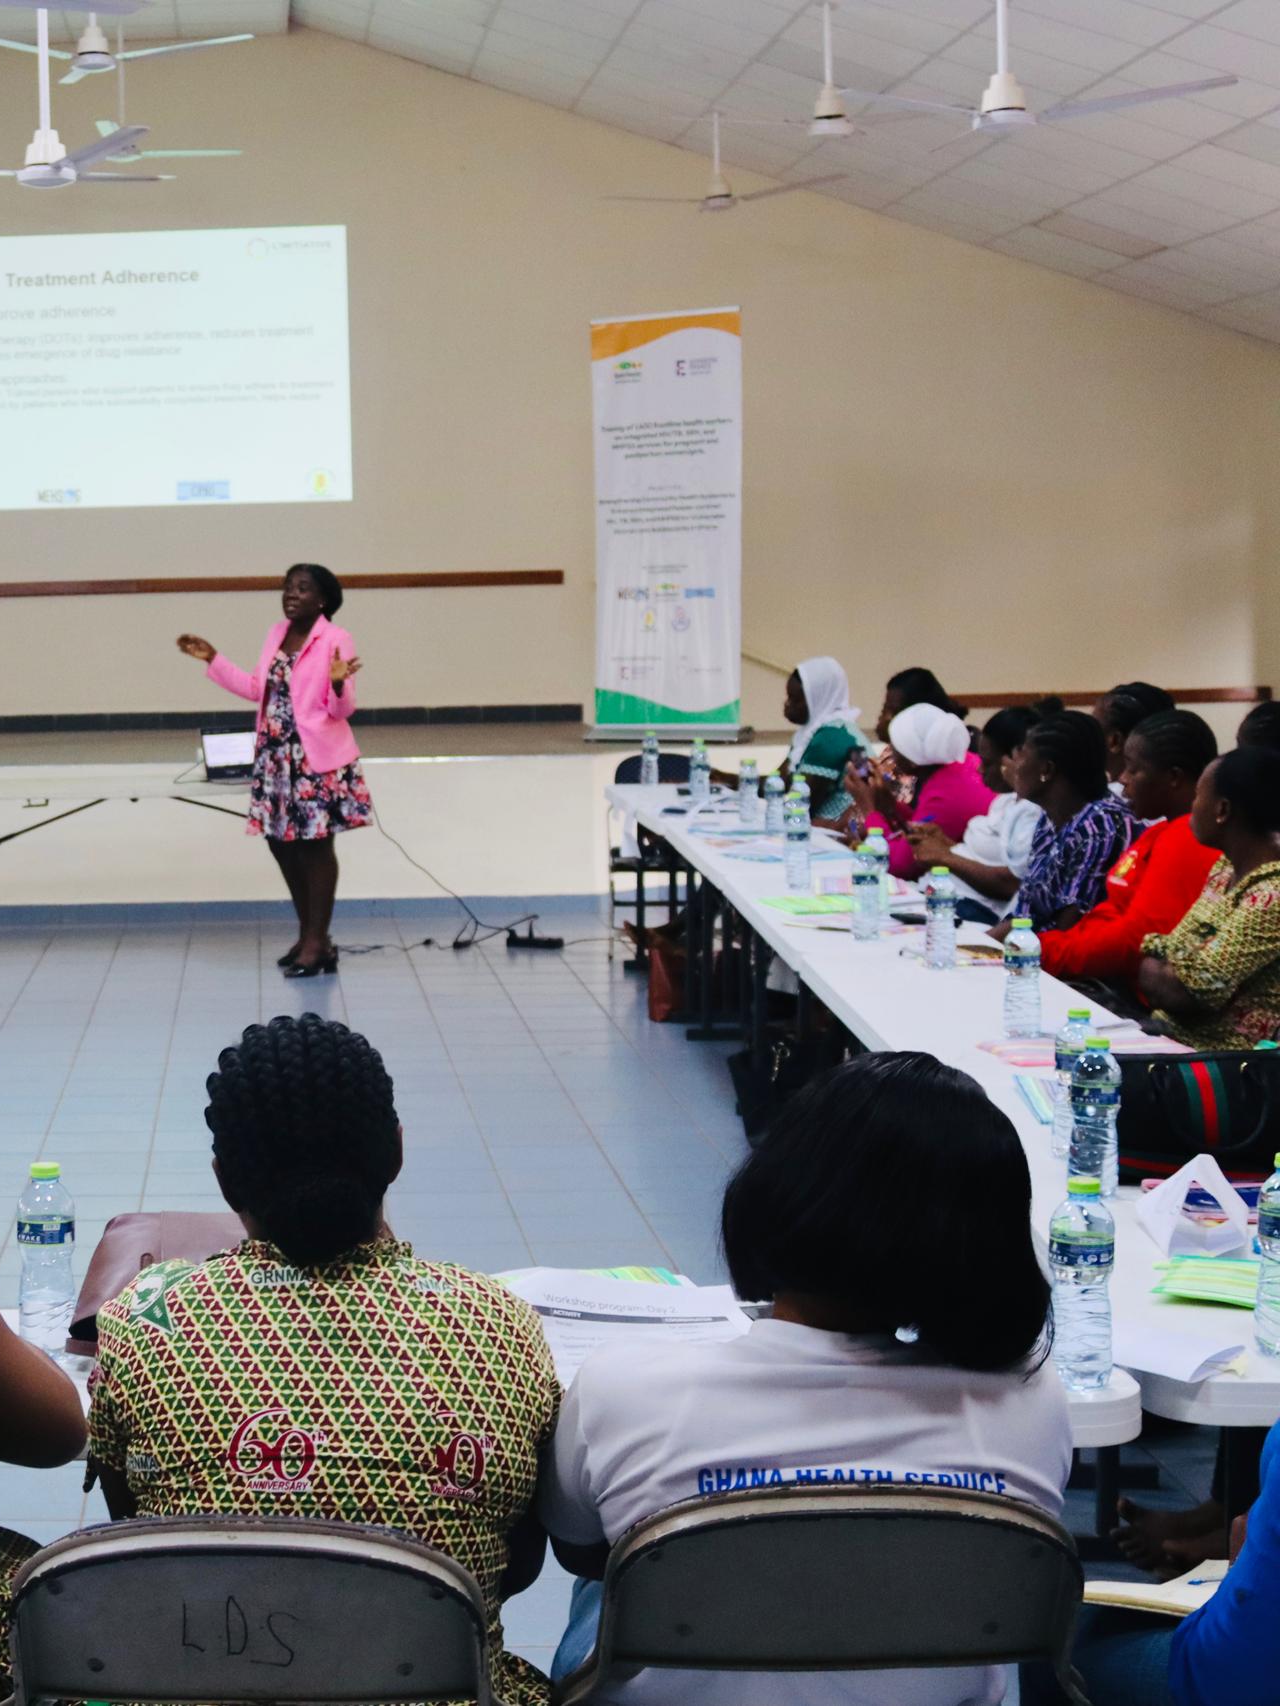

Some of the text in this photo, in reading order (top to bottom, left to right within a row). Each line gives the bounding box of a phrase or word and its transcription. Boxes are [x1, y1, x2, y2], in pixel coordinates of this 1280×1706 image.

[5, 269, 200, 288] Treatment Adherence
[40, 304, 116, 319] adherence
[250, 1268, 311, 1284] GRNMA
[543, 1293, 596, 1309] Workshop
[247, 1480, 308, 1491] ANNIVERSARY
[697, 1467, 784, 1495] GHANA
